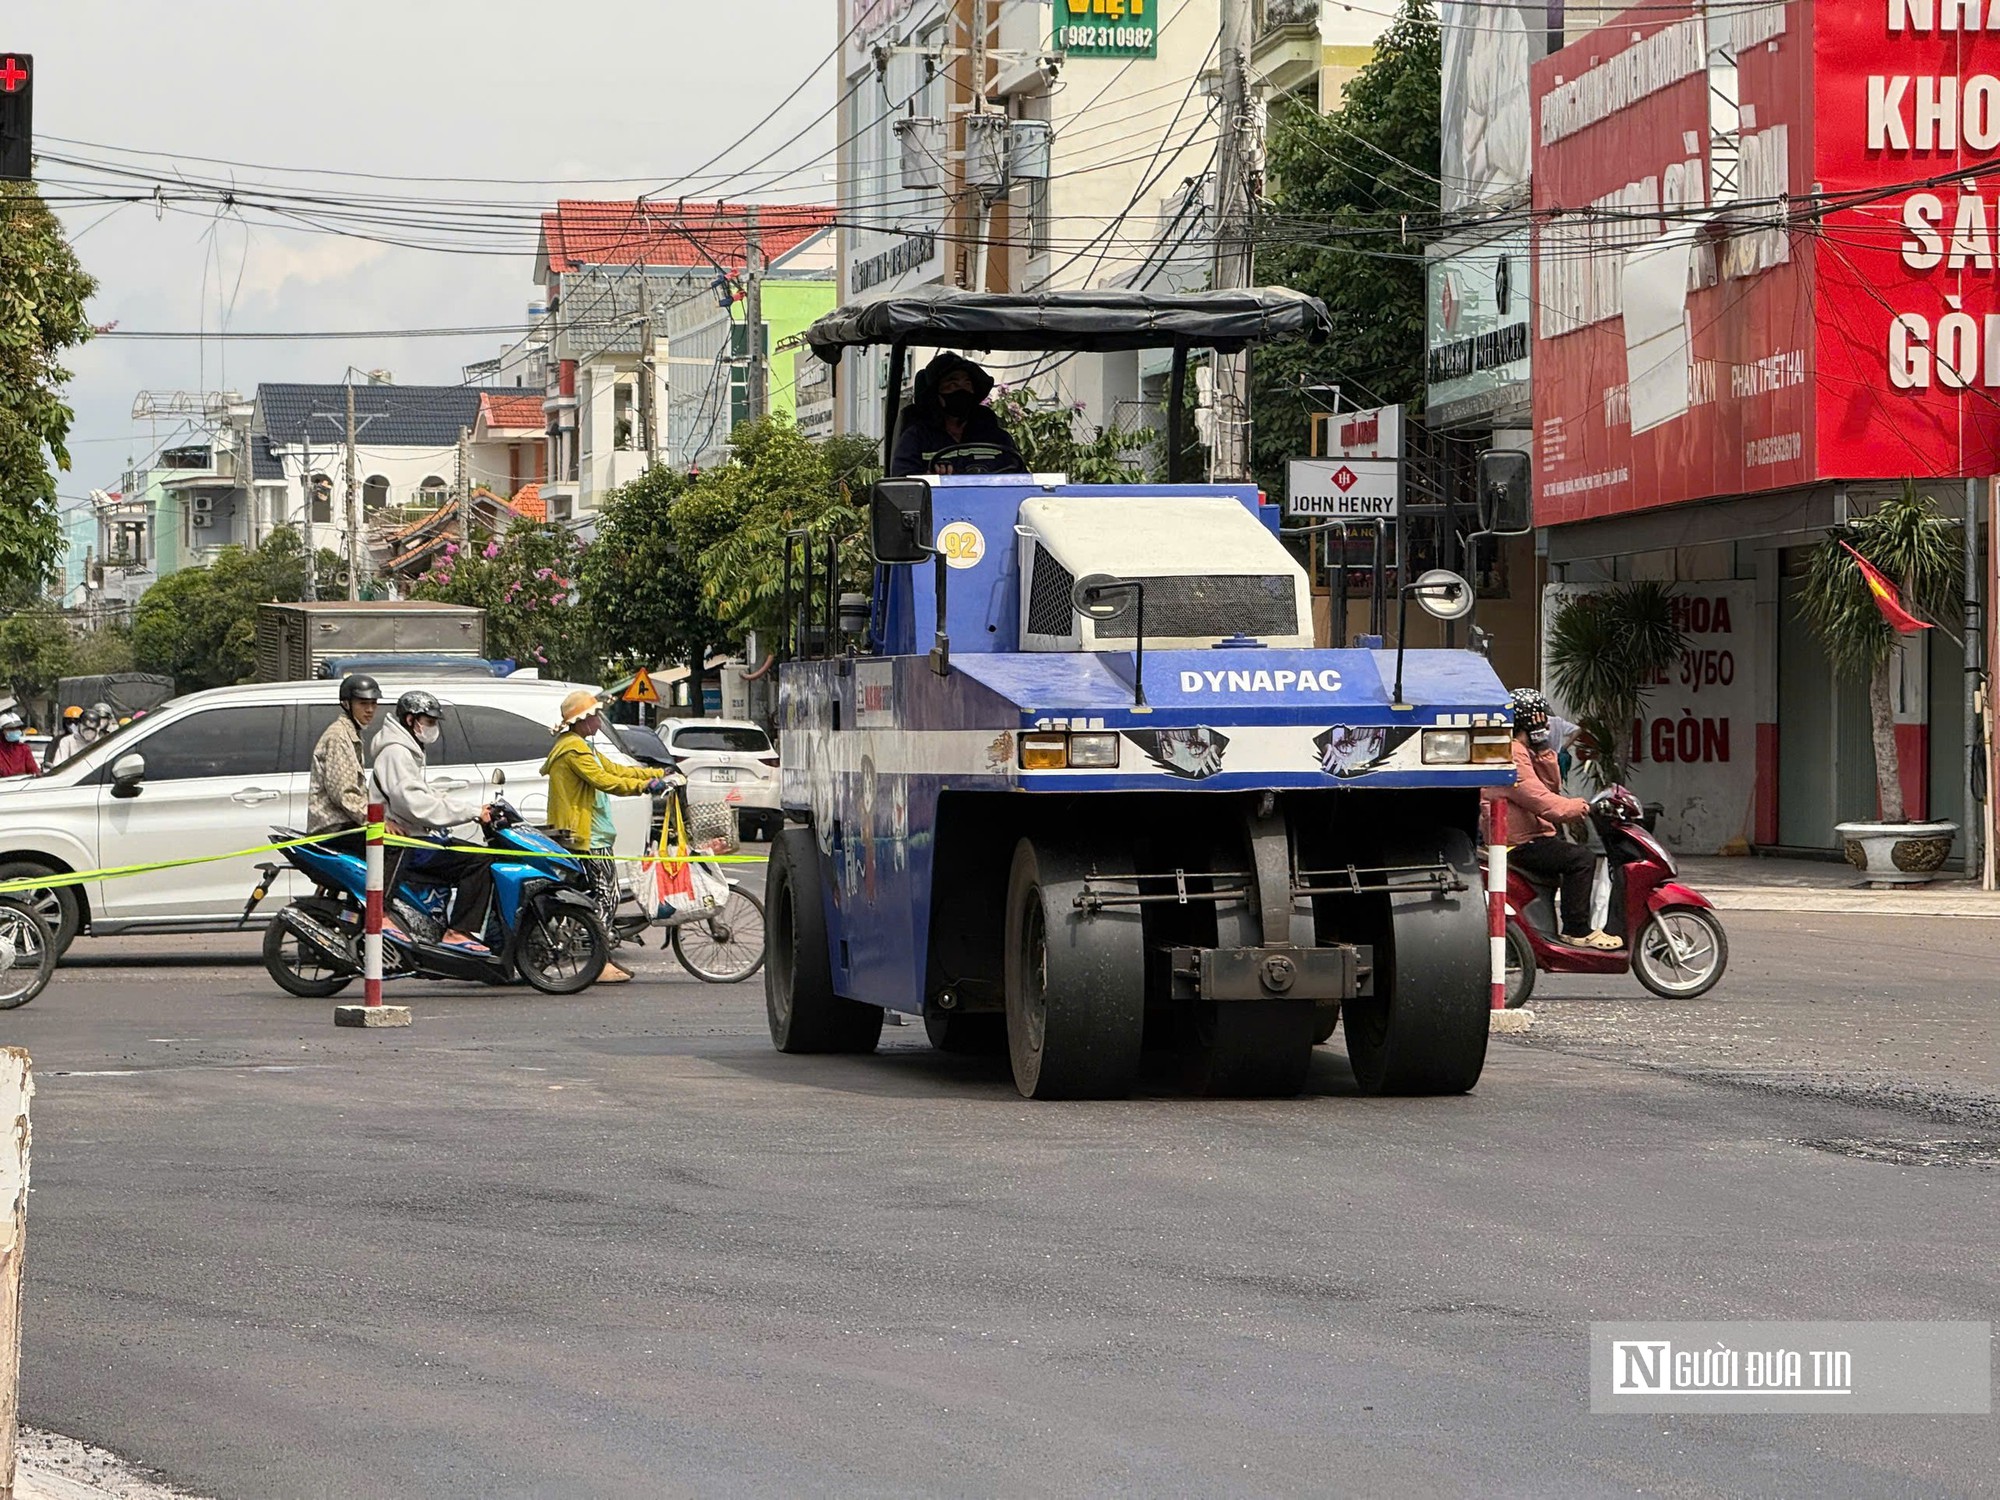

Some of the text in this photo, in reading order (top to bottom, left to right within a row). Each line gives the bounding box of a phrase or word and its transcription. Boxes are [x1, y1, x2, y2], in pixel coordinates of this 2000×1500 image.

[1867, 74, 2000, 150] KHO
[1901, 177, 2000, 269] SÀ
[1292, 496, 1394, 513] JOHN HENRY
[945, 532, 977, 558] 92
[1180, 669, 1342, 692] DYNAPAC
[1651, 708, 1730, 763] GÒN
